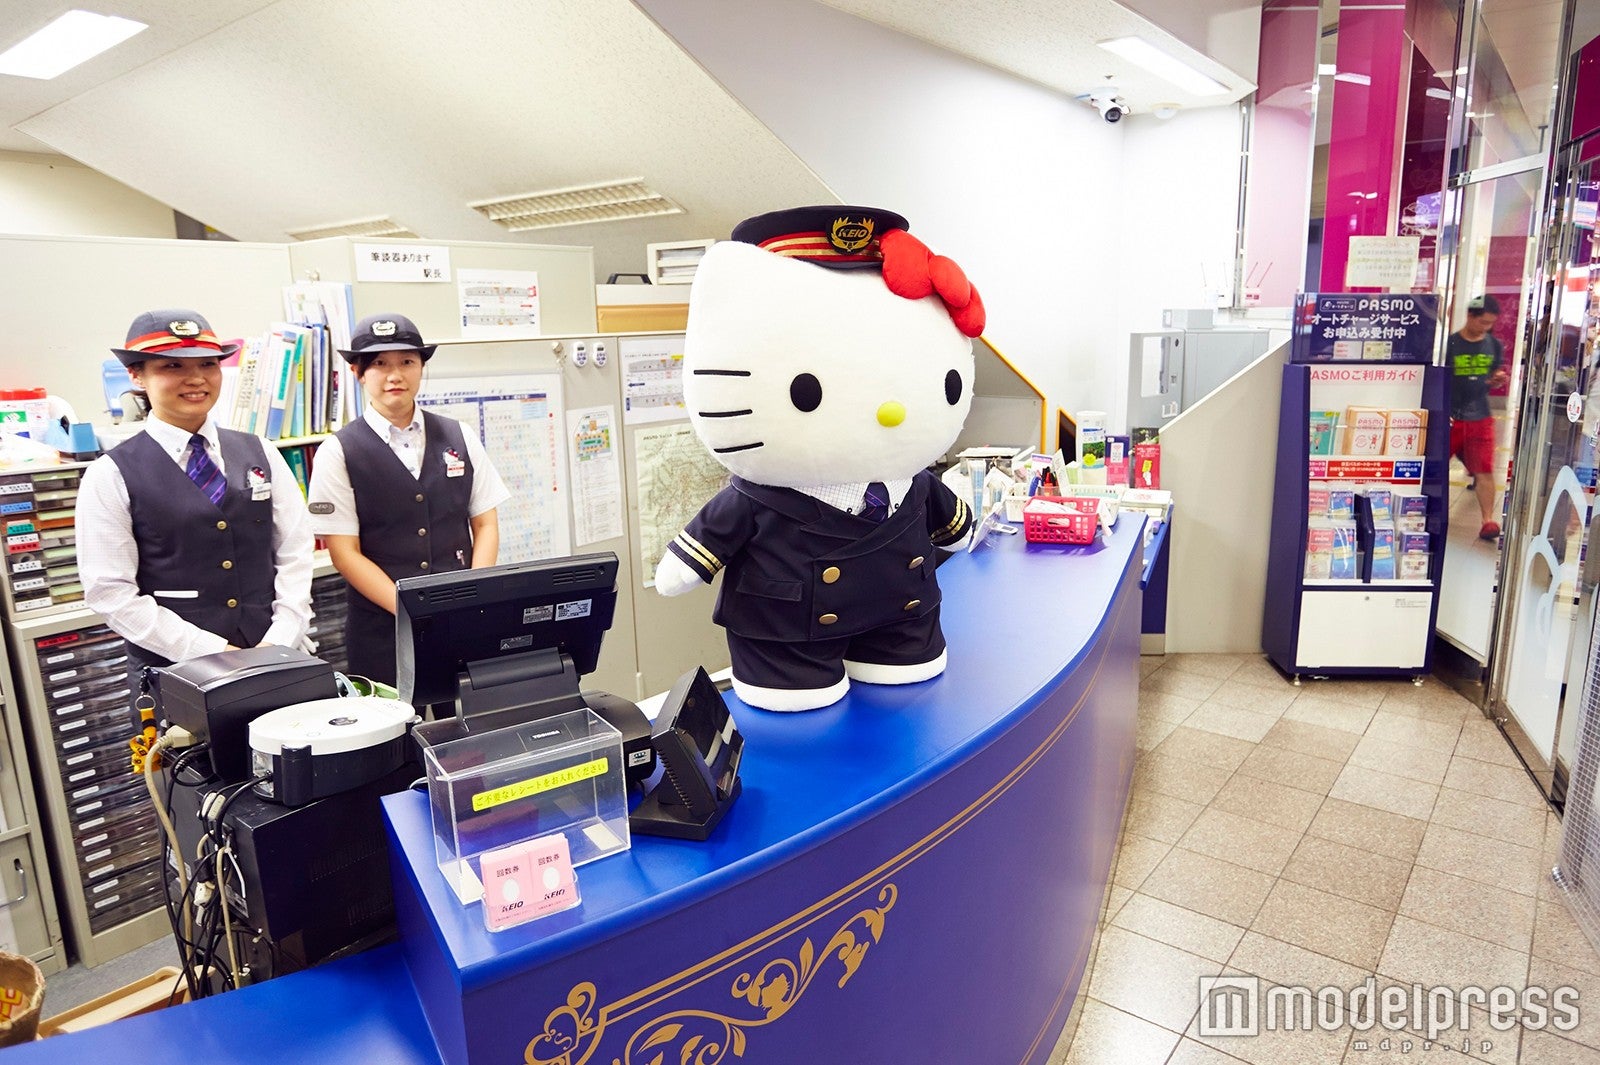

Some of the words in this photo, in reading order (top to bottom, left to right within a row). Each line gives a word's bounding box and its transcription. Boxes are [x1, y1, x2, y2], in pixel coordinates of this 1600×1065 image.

[838, 228, 868, 238] KEIO
[1358, 299, 1414, 311] PASMO
[1311, 313, 1420, 325] オートチャージサービス
[1322, 327, 1406, 339] お申込み受付中
[1310, 370, 1418, 381] ASMOご利用ガイド
[476, 763, 606, 807] ご不要なレシートをお入れください
[538, 853, 560, 866] 回数券
[496, 865, 520, 878] 回数券
[501, 900, 524, 913] KEIO
